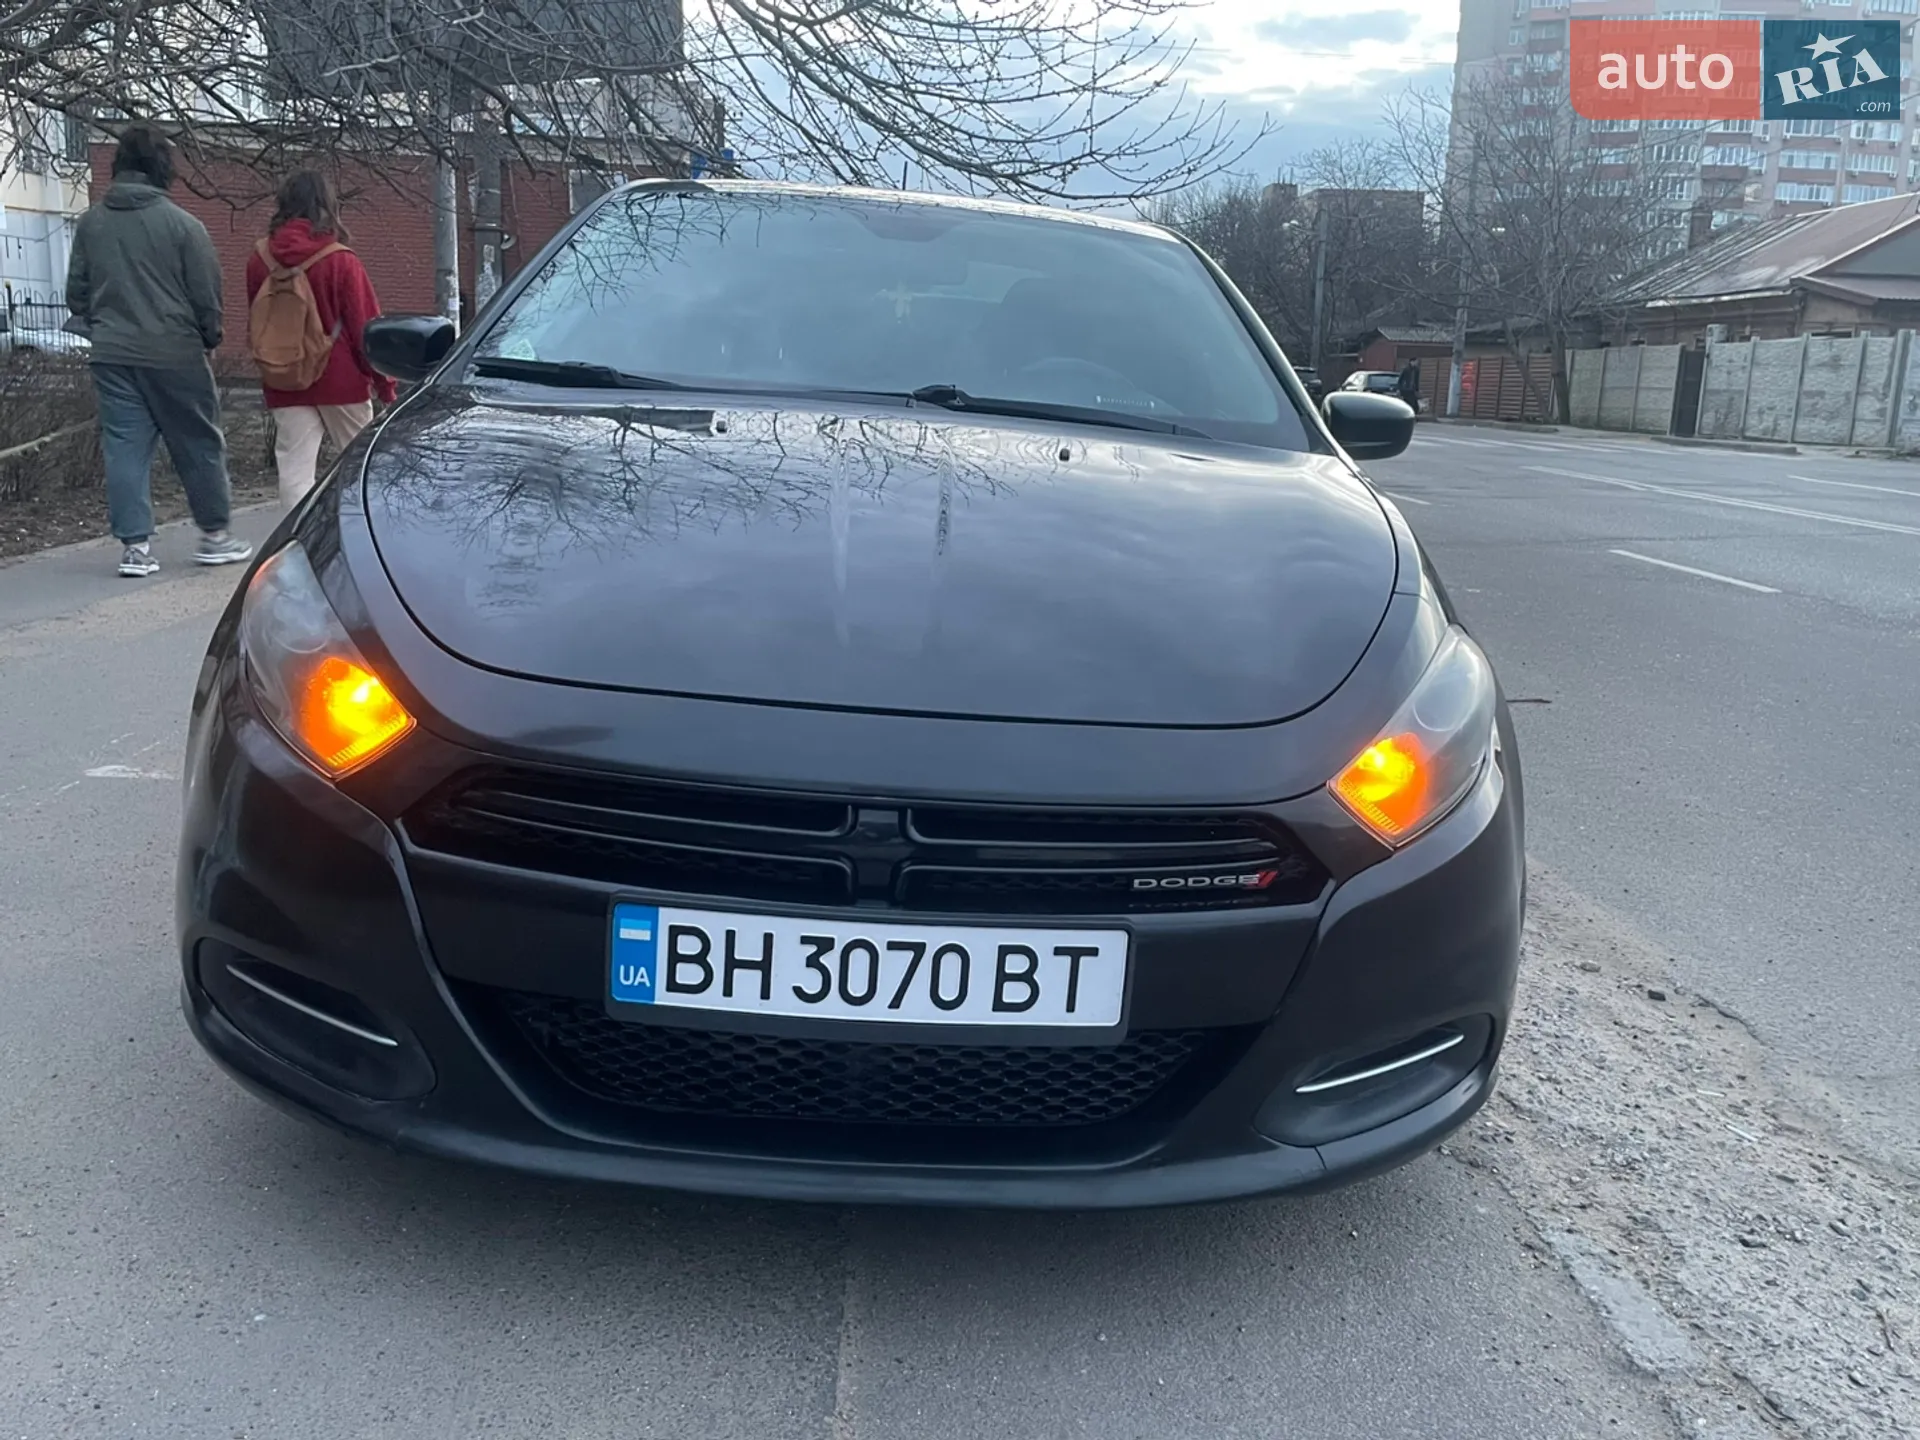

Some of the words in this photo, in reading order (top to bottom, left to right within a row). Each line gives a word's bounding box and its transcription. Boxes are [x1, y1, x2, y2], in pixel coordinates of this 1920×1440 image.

[1133, 874, 1260, 889] DODGE
[619, 964, 651, 987] UA
[792, 935, 970, 1011] 3070
